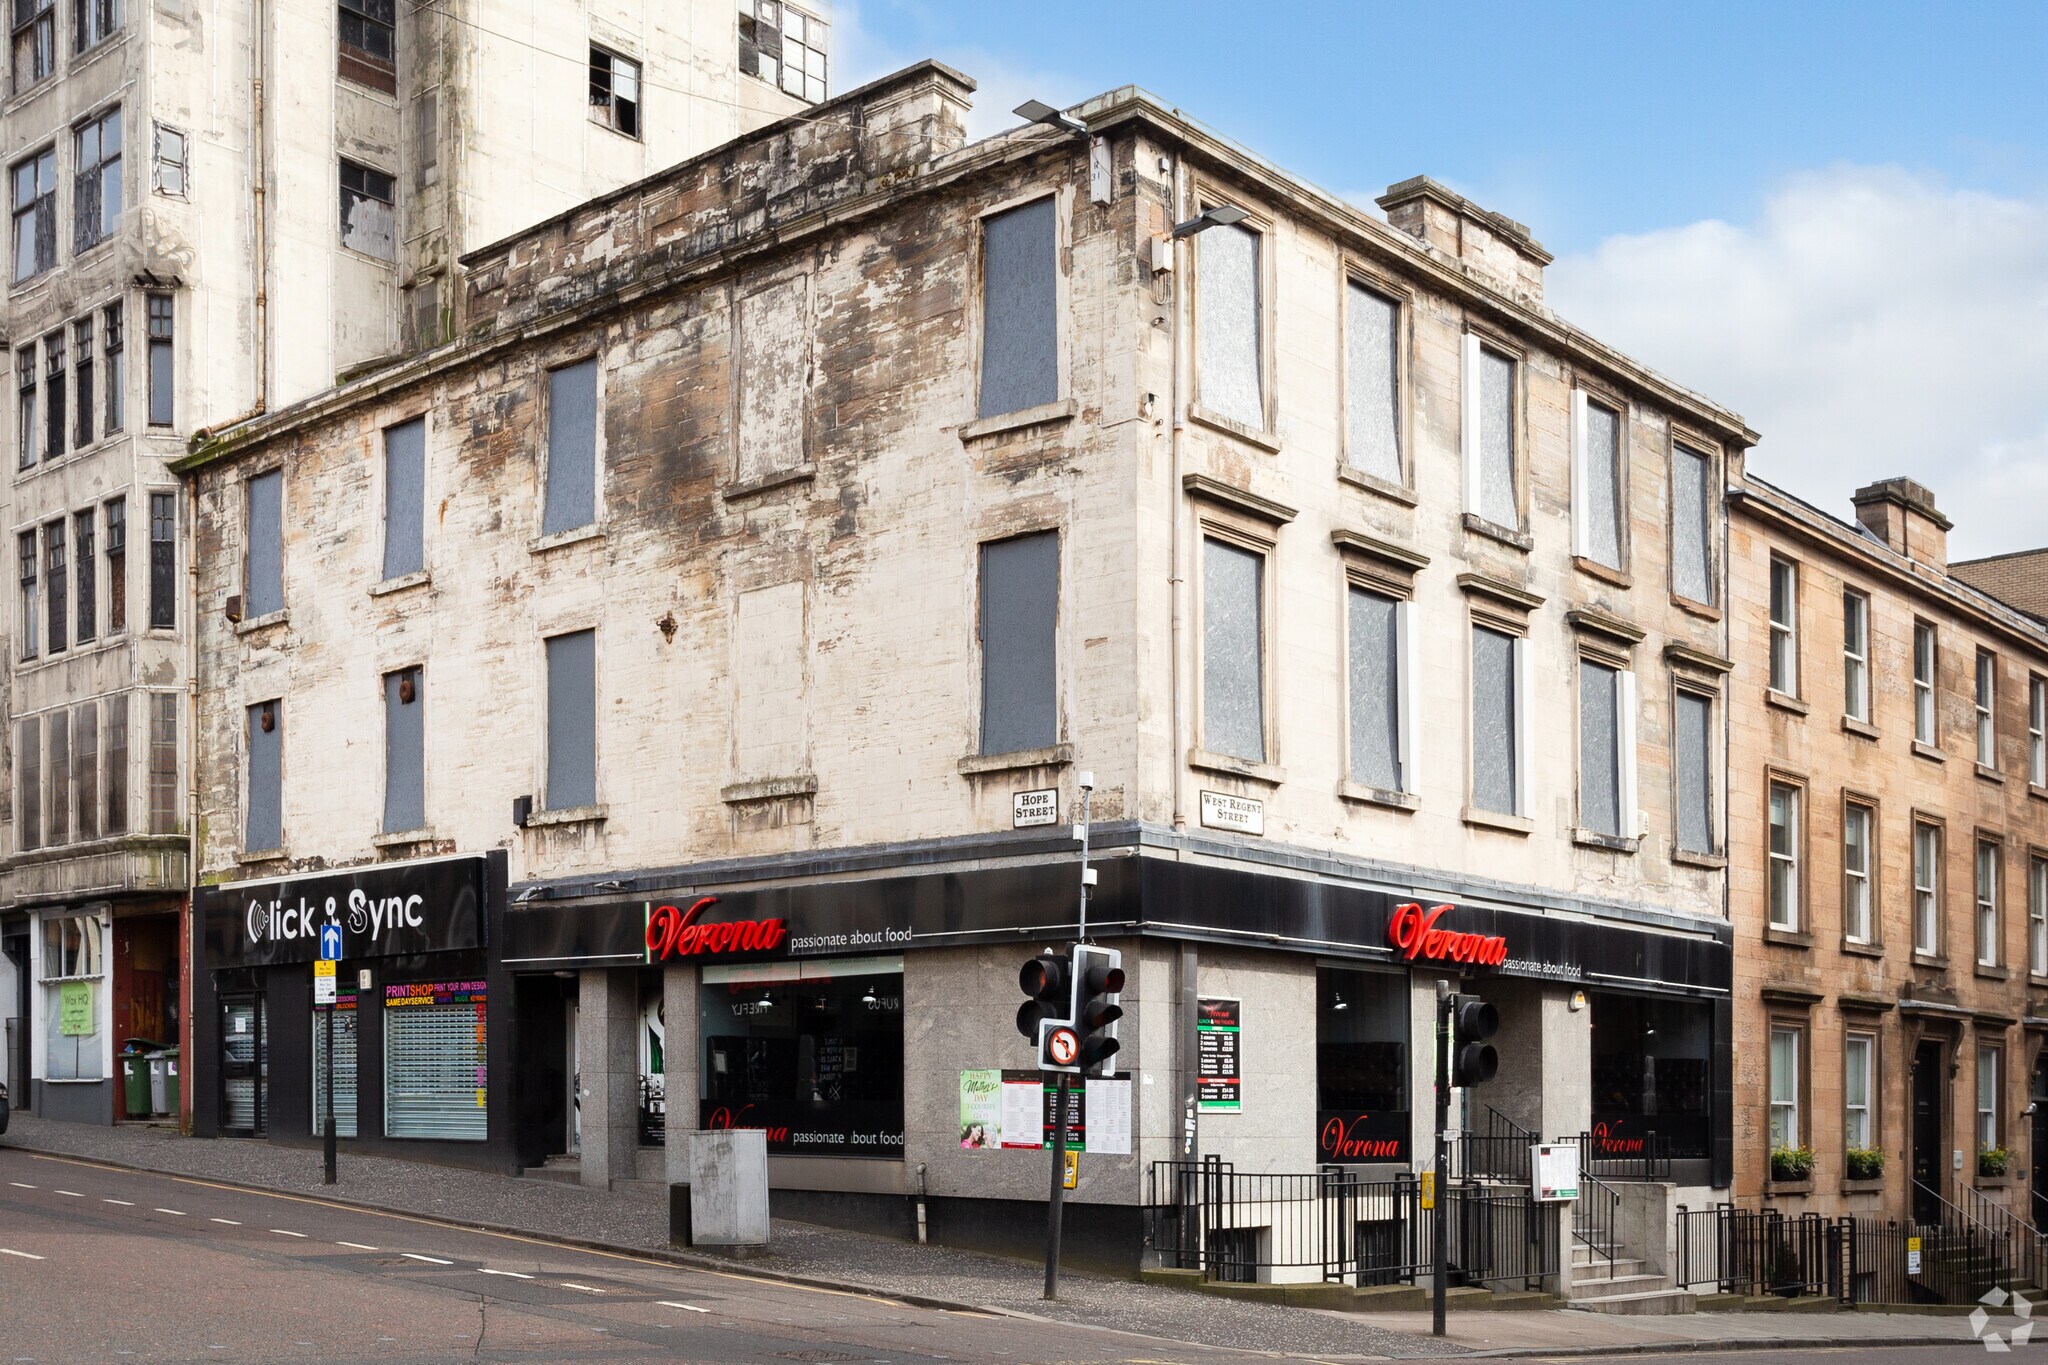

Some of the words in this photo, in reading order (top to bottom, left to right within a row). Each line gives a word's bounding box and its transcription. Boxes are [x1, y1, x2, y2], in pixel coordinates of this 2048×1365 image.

[1021, 795, 1048, 806] HOPE
[1203, 794, 1227, 807] WEST
[1229, 799, 1261, 814] REGENT
[1016, 806, 1054, 818] STREET
[1217, 808, 1249, 823] STREET
[348, 888, 423, 941] Sync
[646, 898, 787, 960] Verona
[791, 935, 847, 951] passionate
[850, 929, 882, 944] about
[886, 925, 912, 942] food
[1389, 902, 1508, 965] Verona
[1503, 957, 1541, 973] passionate
[1543, 960, 1564, 975] about
[1565, 962, 1581, 977] food
[434, 983, 446, 991] PRINT
[447, 982, 460, 991] YOUR
[461, 982, 470, 990] OWN
[471, 981, 487, 990] DESIGN
[78, 993, 89, 1005] HQ
[969, 1072, 992, 1080] HAPPY
[974, 1094, 988, 1102] DAY
[793, 1131, 845, 1146] passionate
[880, 1130, 904, 1145] food
[1322, 1115, 1399, 1159] Verona
[1592, 1119, 1645, 1153] Verona
